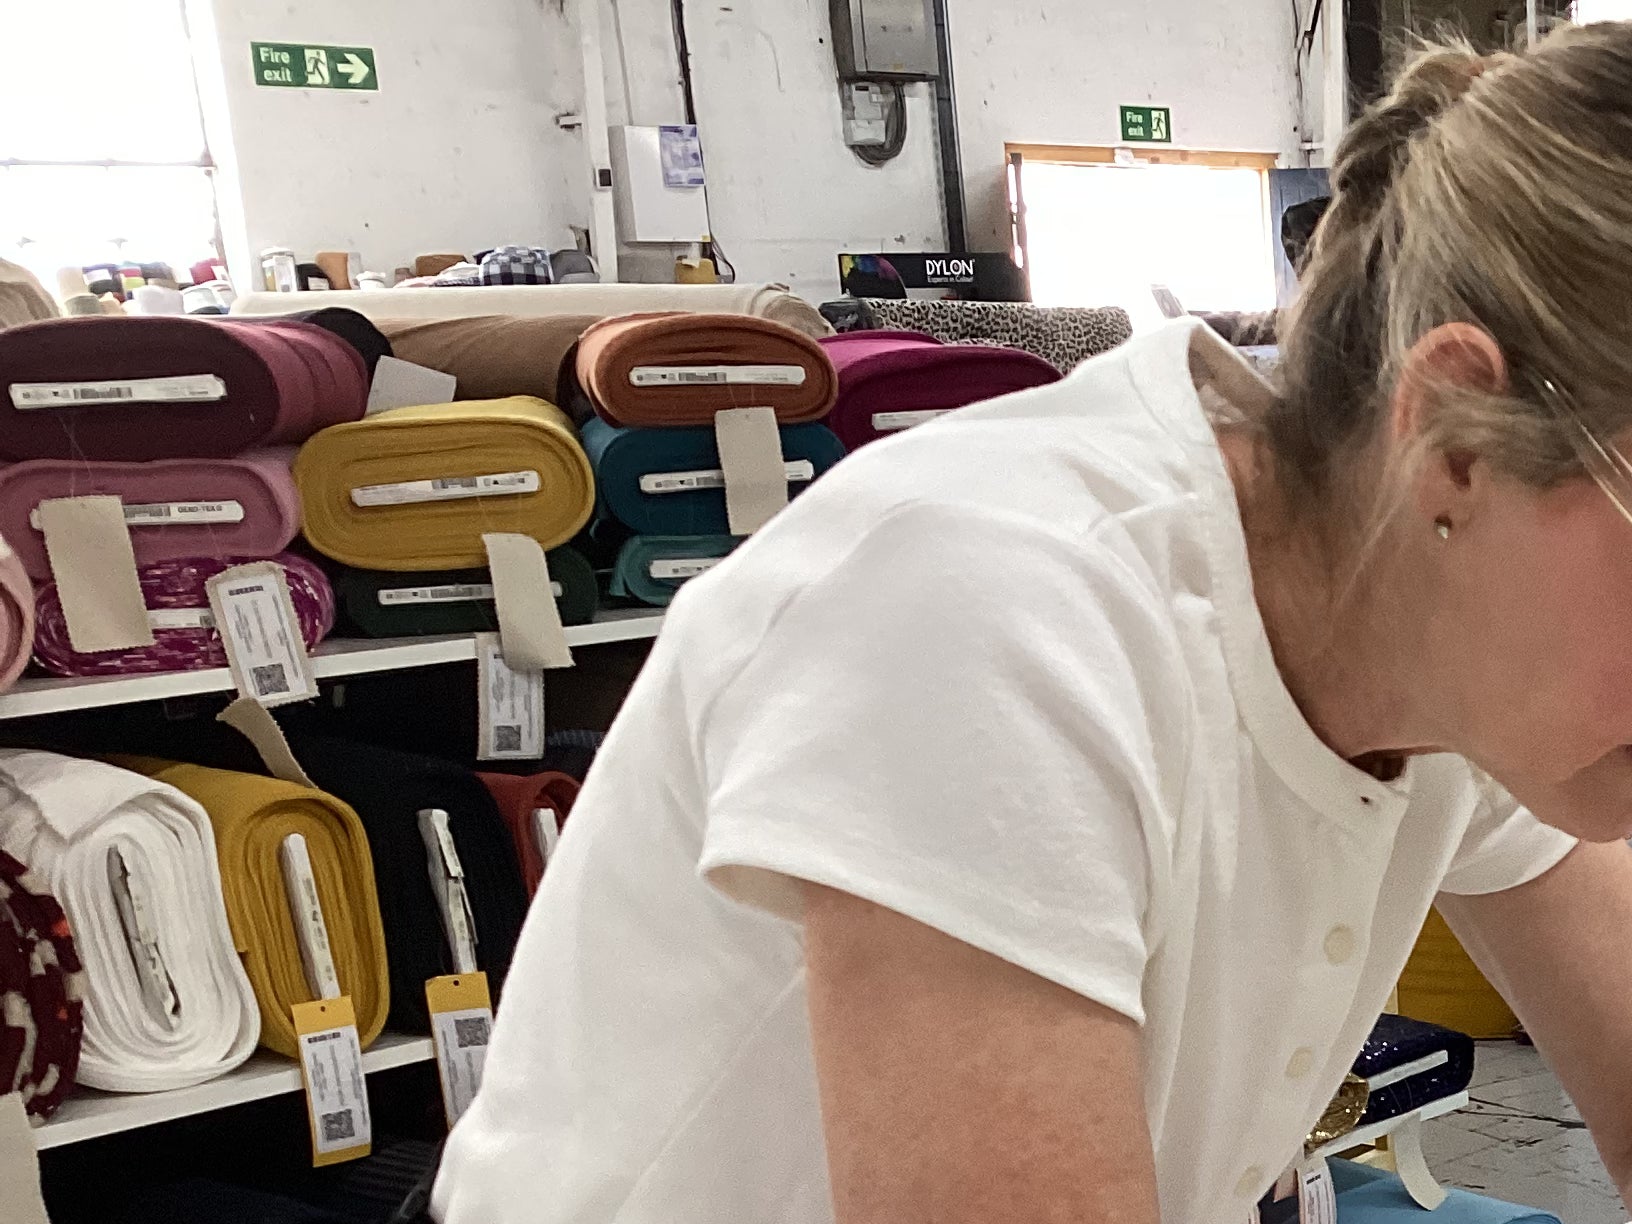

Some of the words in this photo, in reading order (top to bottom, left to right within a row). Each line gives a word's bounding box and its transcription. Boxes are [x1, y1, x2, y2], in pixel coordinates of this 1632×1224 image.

[259, 46, 290, 64] Fire
[263, 67, 292, 82] exit
[1126, 111, 1143, 123] Fire
